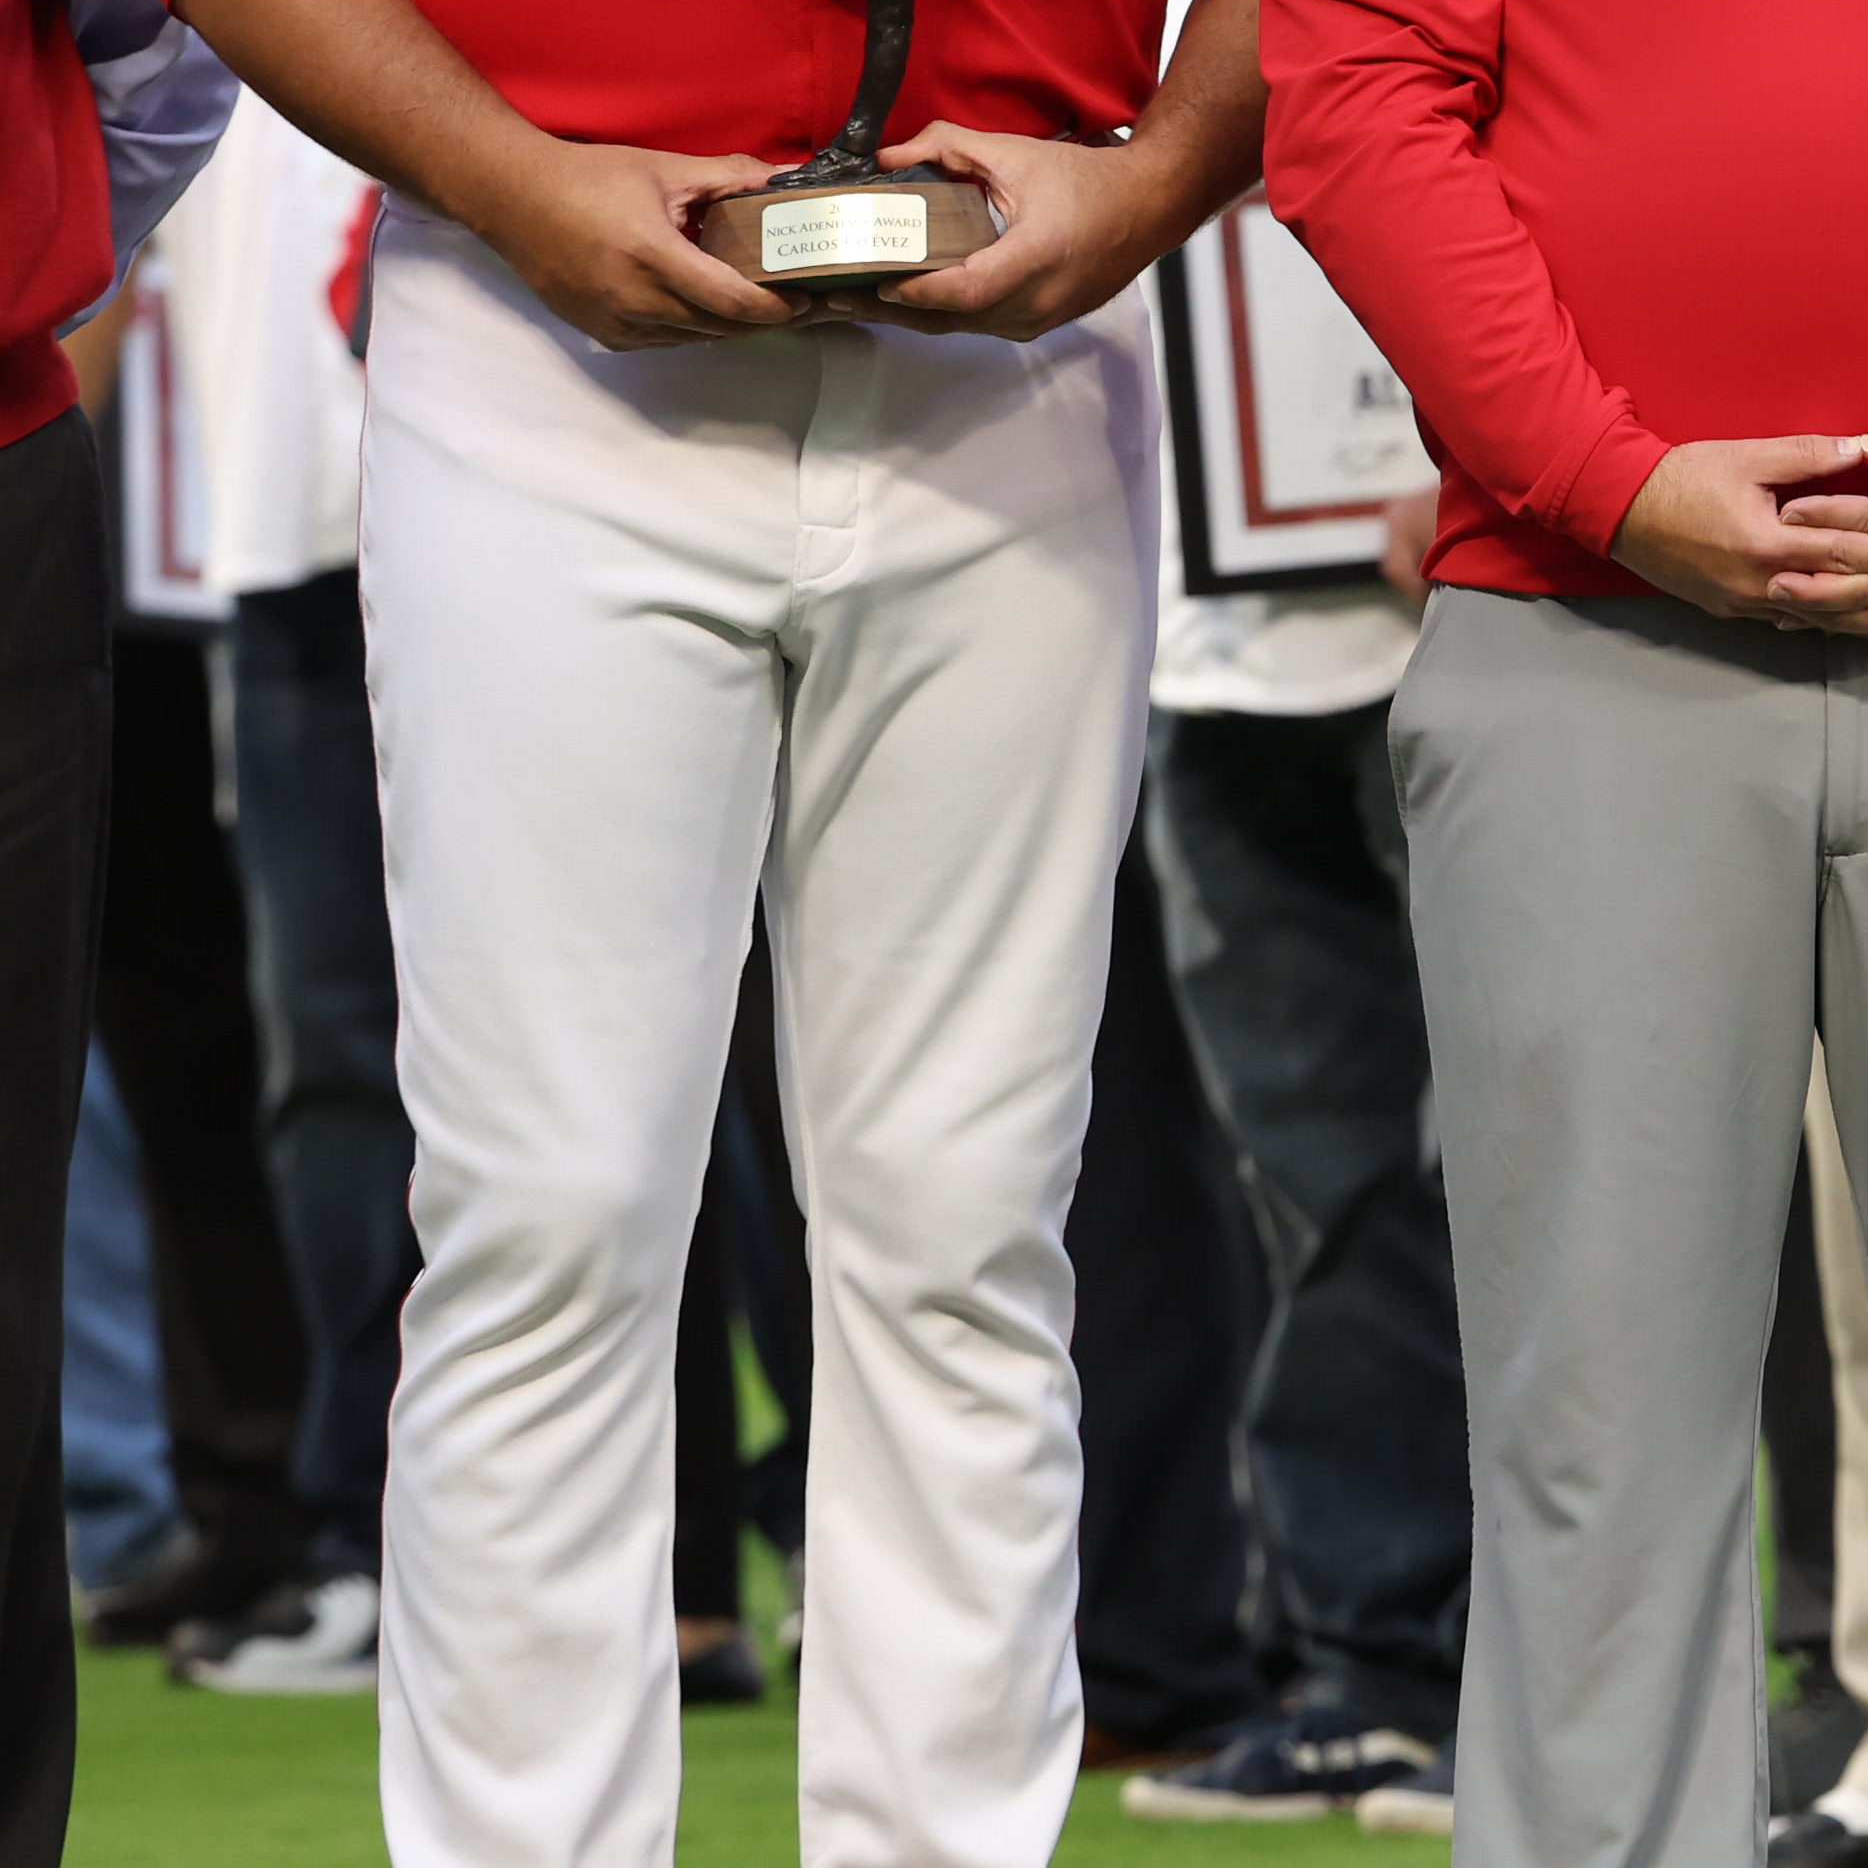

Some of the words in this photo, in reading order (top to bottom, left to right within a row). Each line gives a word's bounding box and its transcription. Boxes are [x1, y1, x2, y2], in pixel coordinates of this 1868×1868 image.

[766, 224, 797, 239] NICK
[799, 218, 868, 234] ADENH
[873, 216, 922, 229] AWARD
[777, 238, 838, 257] CARLOS
